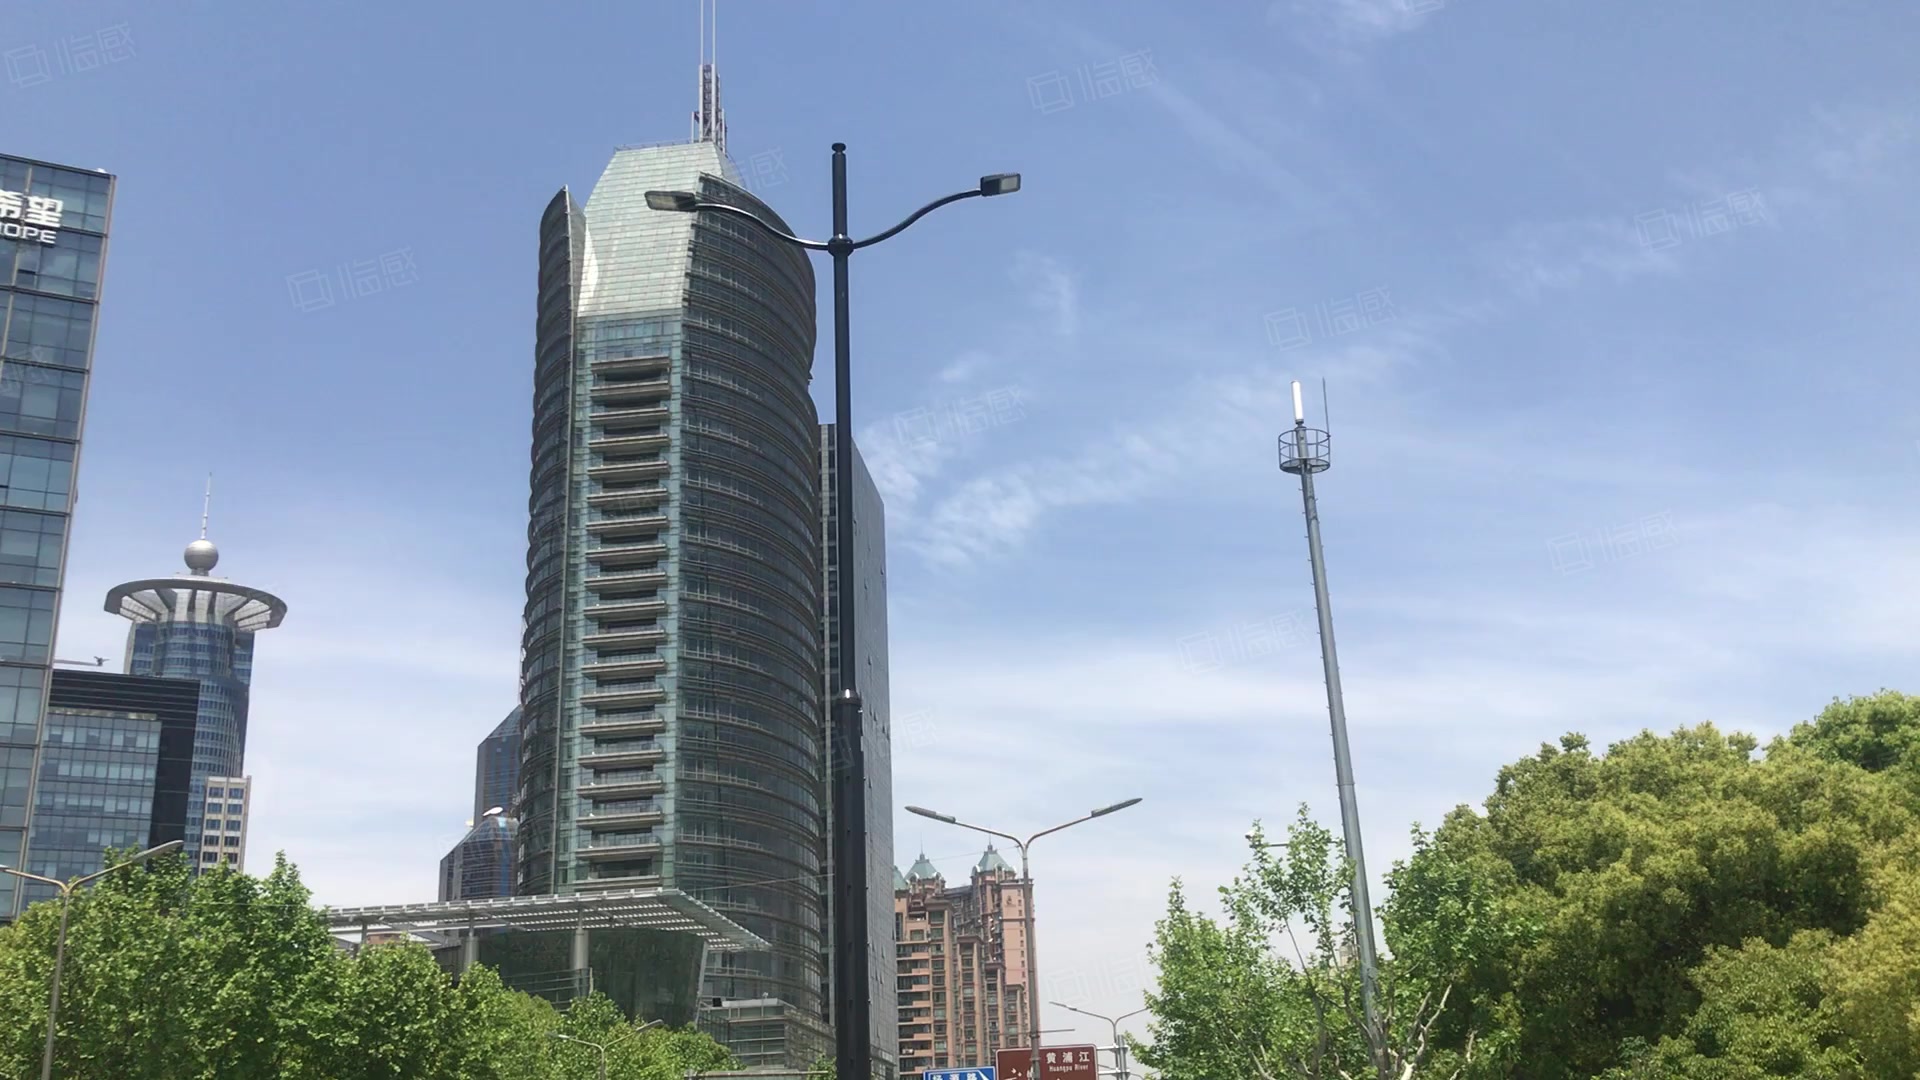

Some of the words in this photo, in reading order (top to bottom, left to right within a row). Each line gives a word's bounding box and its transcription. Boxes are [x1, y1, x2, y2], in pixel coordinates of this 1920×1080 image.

[0, 222, 57, 244] OPE
[1046, 1051, 1090, 1064] 黄浦江
[1049, 1065, 1073, 1073] Huangpu
[1074, 1063, 1089, 1071] River
